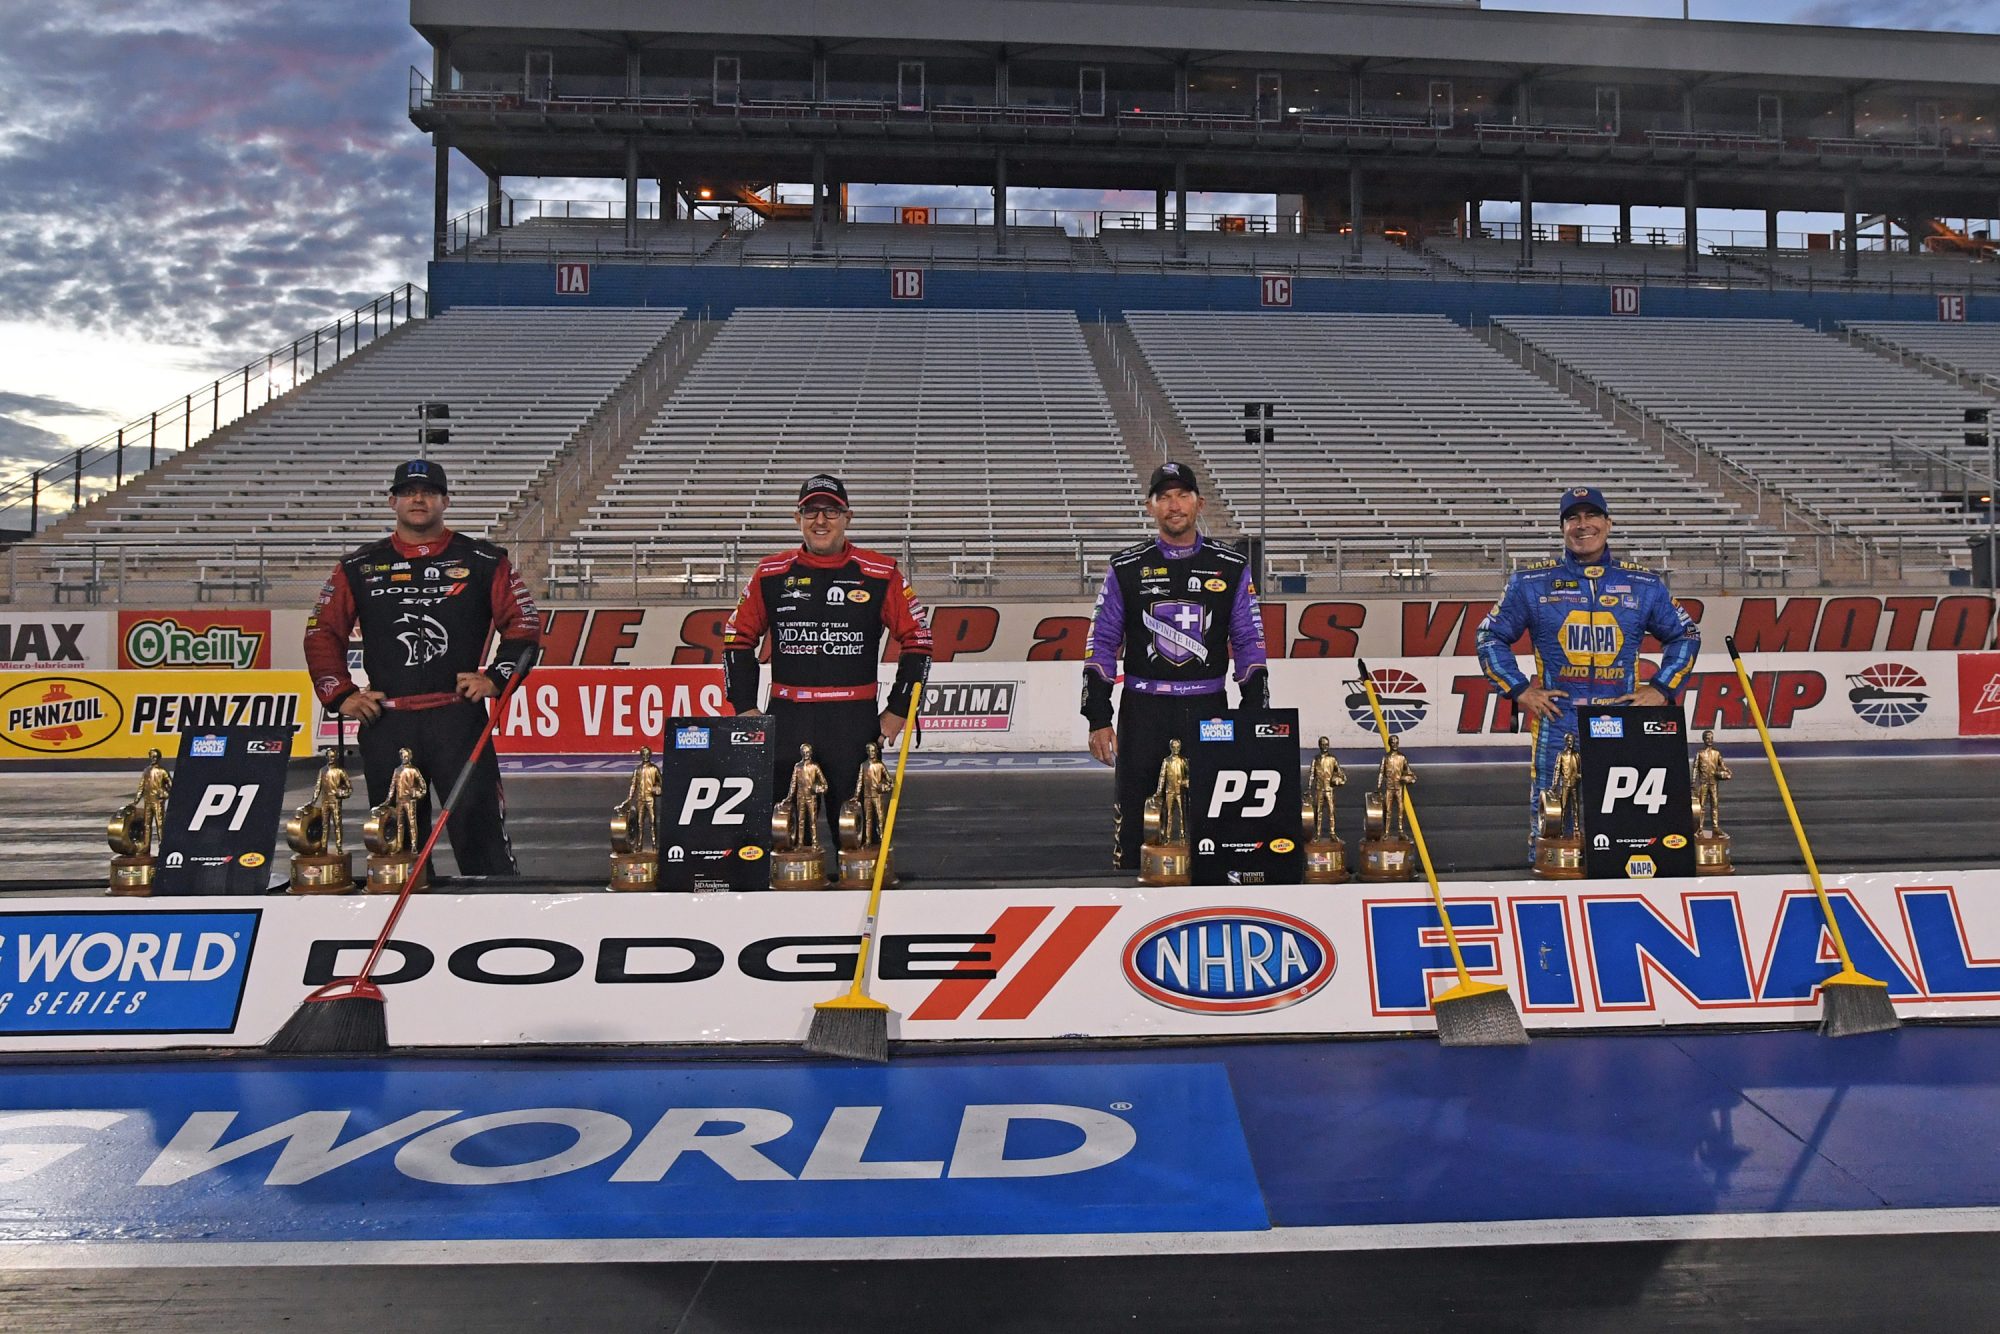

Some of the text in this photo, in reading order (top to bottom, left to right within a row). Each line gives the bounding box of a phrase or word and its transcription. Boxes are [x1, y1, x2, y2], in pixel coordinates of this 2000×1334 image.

[560, 266, 585, 291] 1A
[896, 271, 920, 296] 1B
[1265, 279, 1288, 303] 1C
[1614, 288, 1636, 312] 1D
[1940, 297, 1962, 320] 1E
[371, 585, 454, 597] DODGE
[399, 597, 448, 607] SRT
[531, 609, 645, 666] HE
[1145, 616, 1207, 657] INFINITE HERO
[1568, 625, 1615, 652] NAPA
[1732, 595, 2000, 652] MOTO
[0, 624, 85, 661] AX
[132, 624, 253, 665] O'Reilly
[779, 641, 864, 655] Cancer Center
[1560, 666, 1625, 679] AUTO PARTS
[9, 697, 103, 731] PENNZOIL
[132, 694, 304, 734] PENNZOIL
[578, 684, 723, 737] VEGAS
[922, 687, 1013, 713] PTIMA
[924, 716, 988, 728] BATTERIES
[678, 777, 754, 825] P2
[1207, 770, 1281, 818] P3
[1601, 766, 1668, 814] P4
[187, 783, 260, 831] P1
[1630, 863, 1653, 875] NAPA
[303, 934, 996, 985] DODGE
[1155, 924, 1309, 992] NHRA
[26, 991, 147, 1015] SERIES
